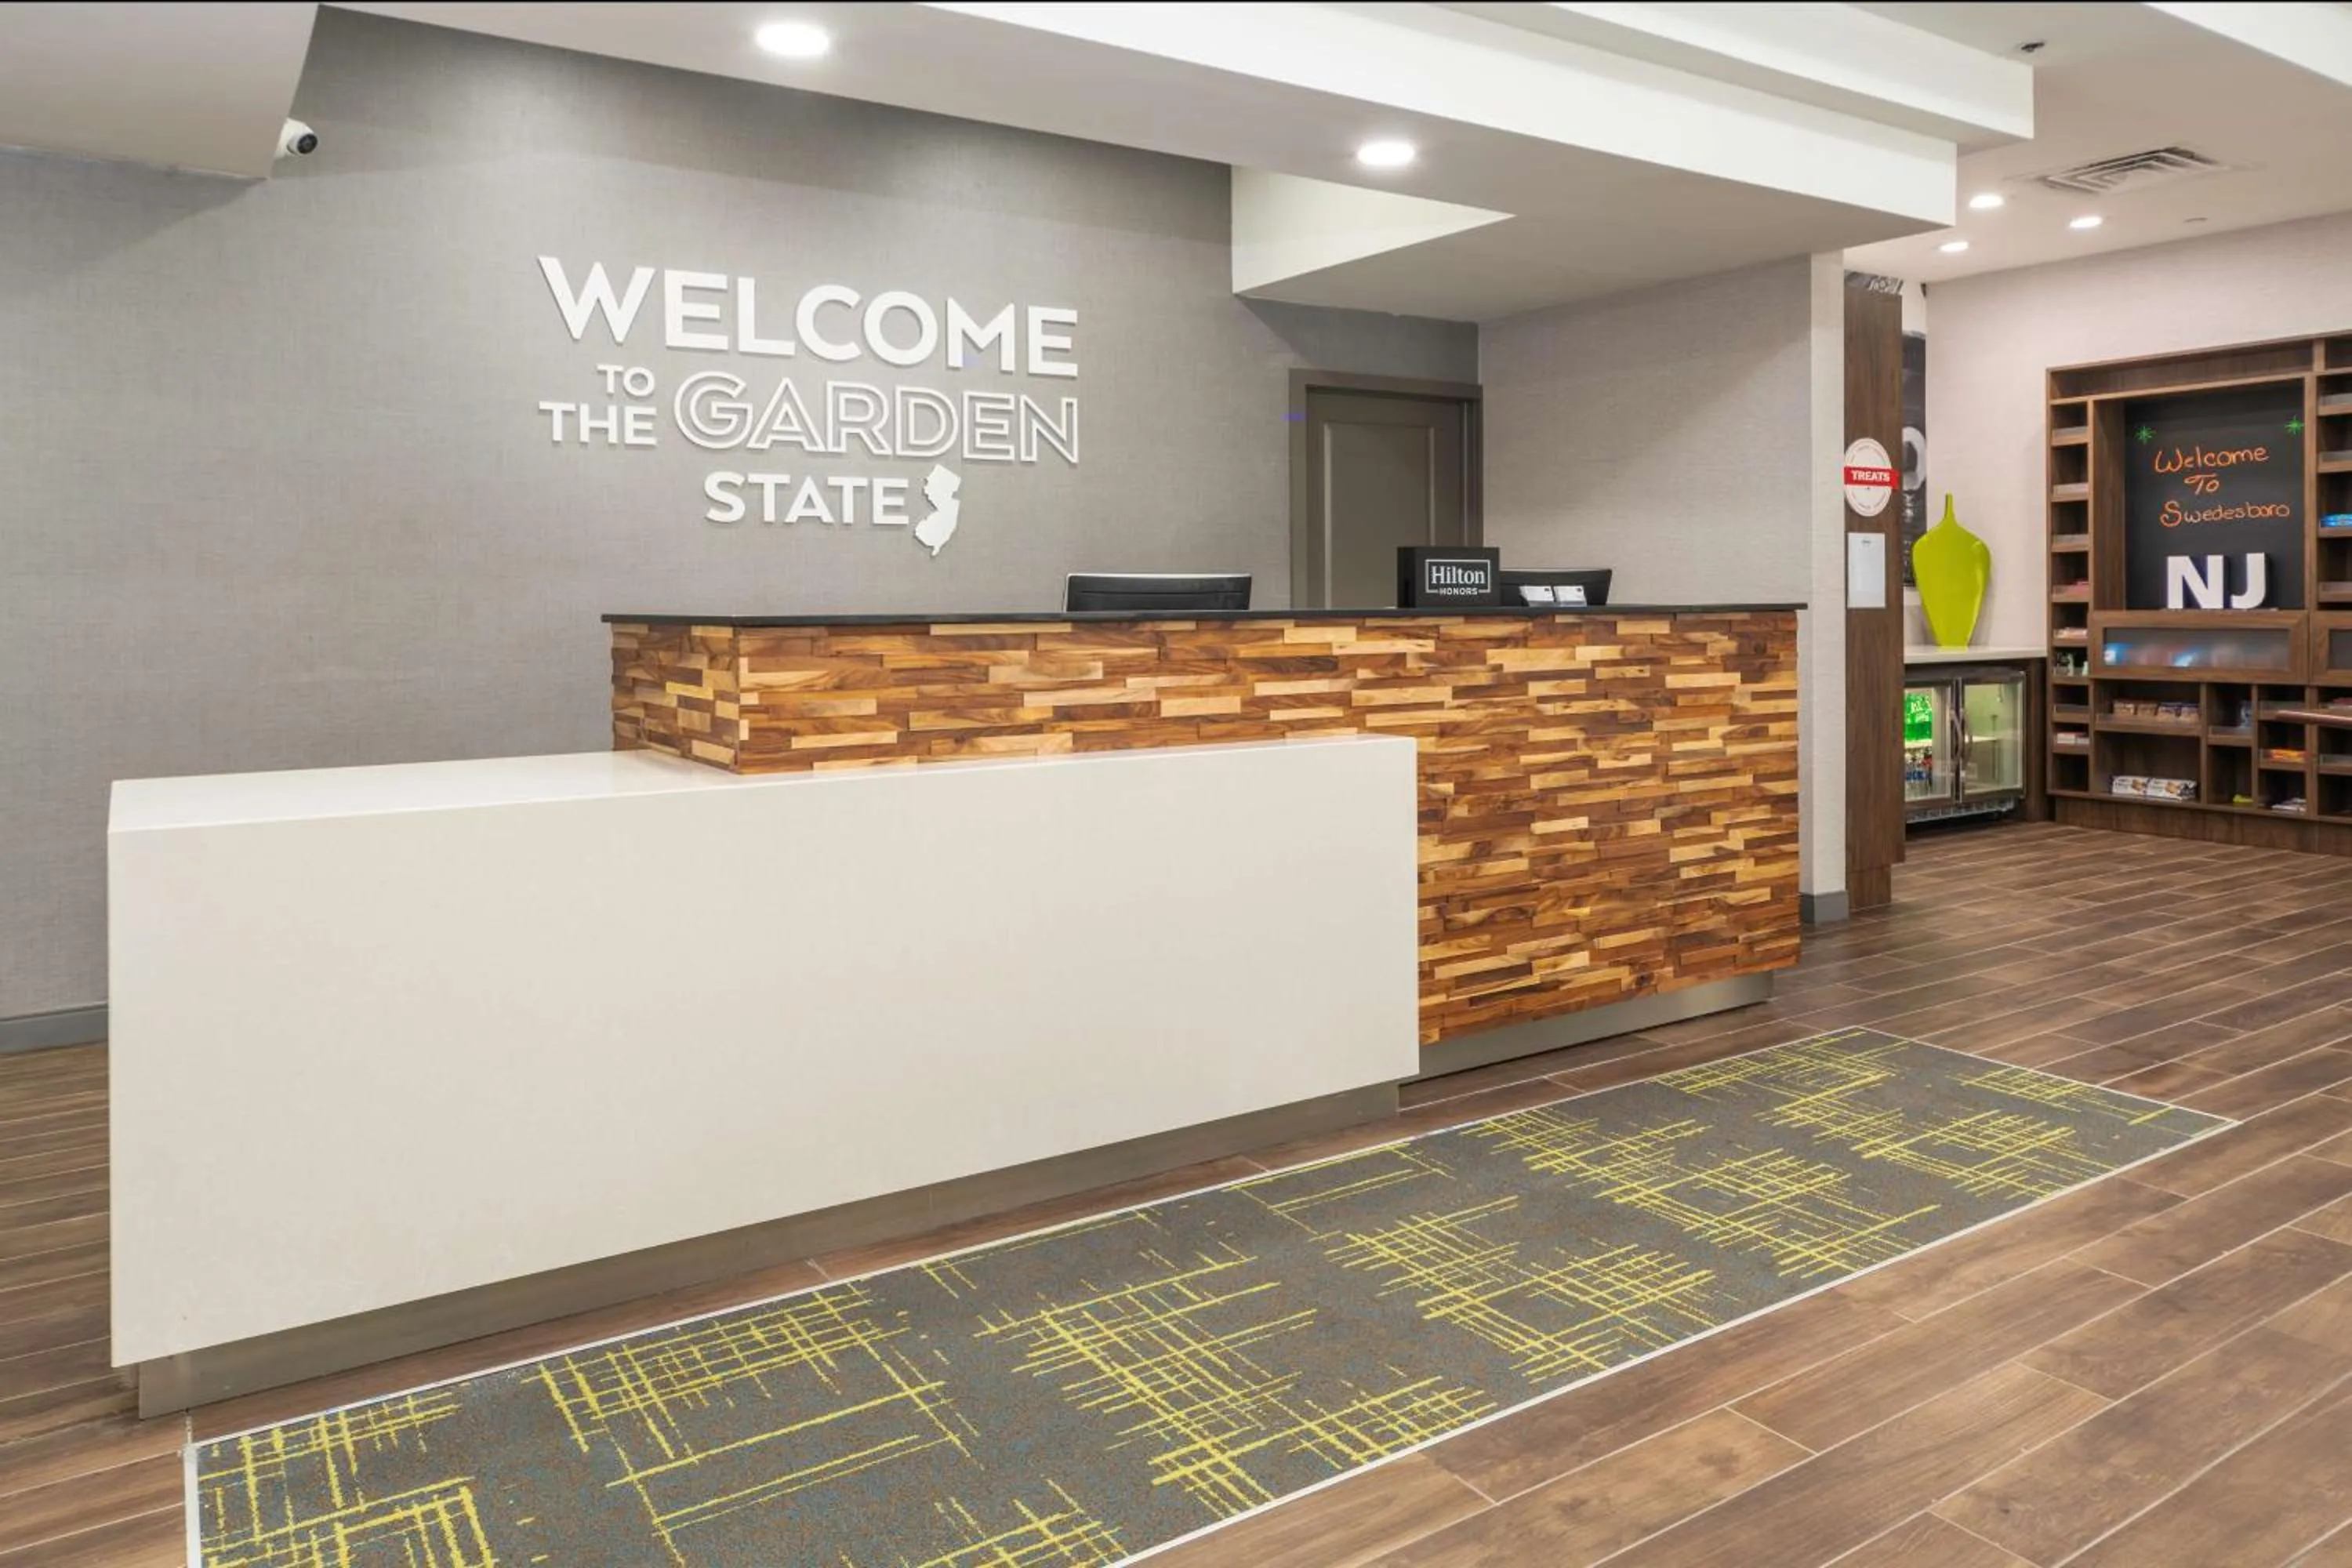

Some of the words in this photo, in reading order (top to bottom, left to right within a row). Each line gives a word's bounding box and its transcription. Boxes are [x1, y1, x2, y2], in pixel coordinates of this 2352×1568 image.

[538, 256, 1078, 377] WELCOME
[597, 364, 655, 397] TO
[539, 401, 657, 445] THE
[673, 371, 1078, 464] GARDEN
[2155, 446, 2270, 473] Welcome
[1851, 470, 1890, 482] TREATS
[2183, 473, 2220, 495] To
[705, 470, 909, 524] STATE
[2160, 499, 2290, 528] Swedesboro
[1431, 565, 1486, 584] Hilton
[2166, 552, 2267, 610] NJ
